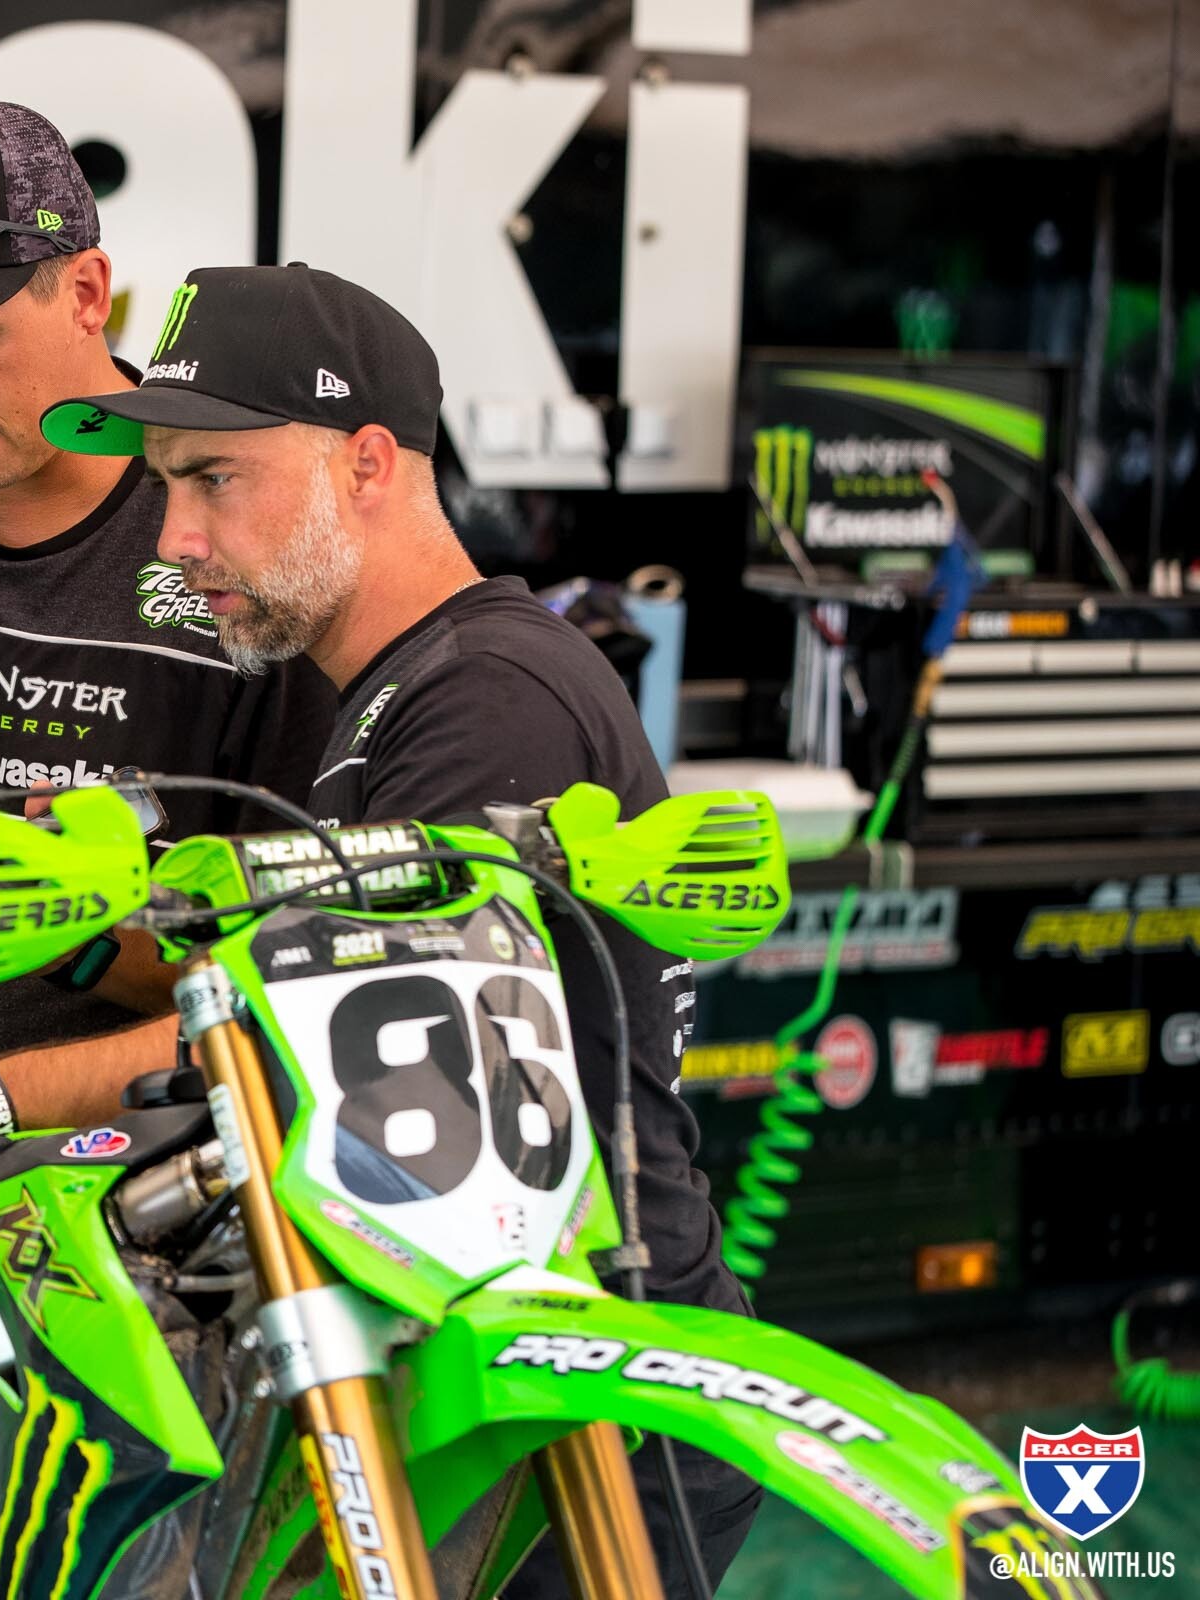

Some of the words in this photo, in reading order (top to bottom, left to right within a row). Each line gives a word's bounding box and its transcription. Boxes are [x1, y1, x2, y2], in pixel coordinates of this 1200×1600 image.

[142, 594, 214, 624] GREE
[333, 930, 385, 958] 2021
[329, 974, 572, 1205] 86
[494, 1333, 628, 1375] PRO
[620, 1348, 890, 1444] CIRCUIT
[321, 1432, 384, 1549] PRO
